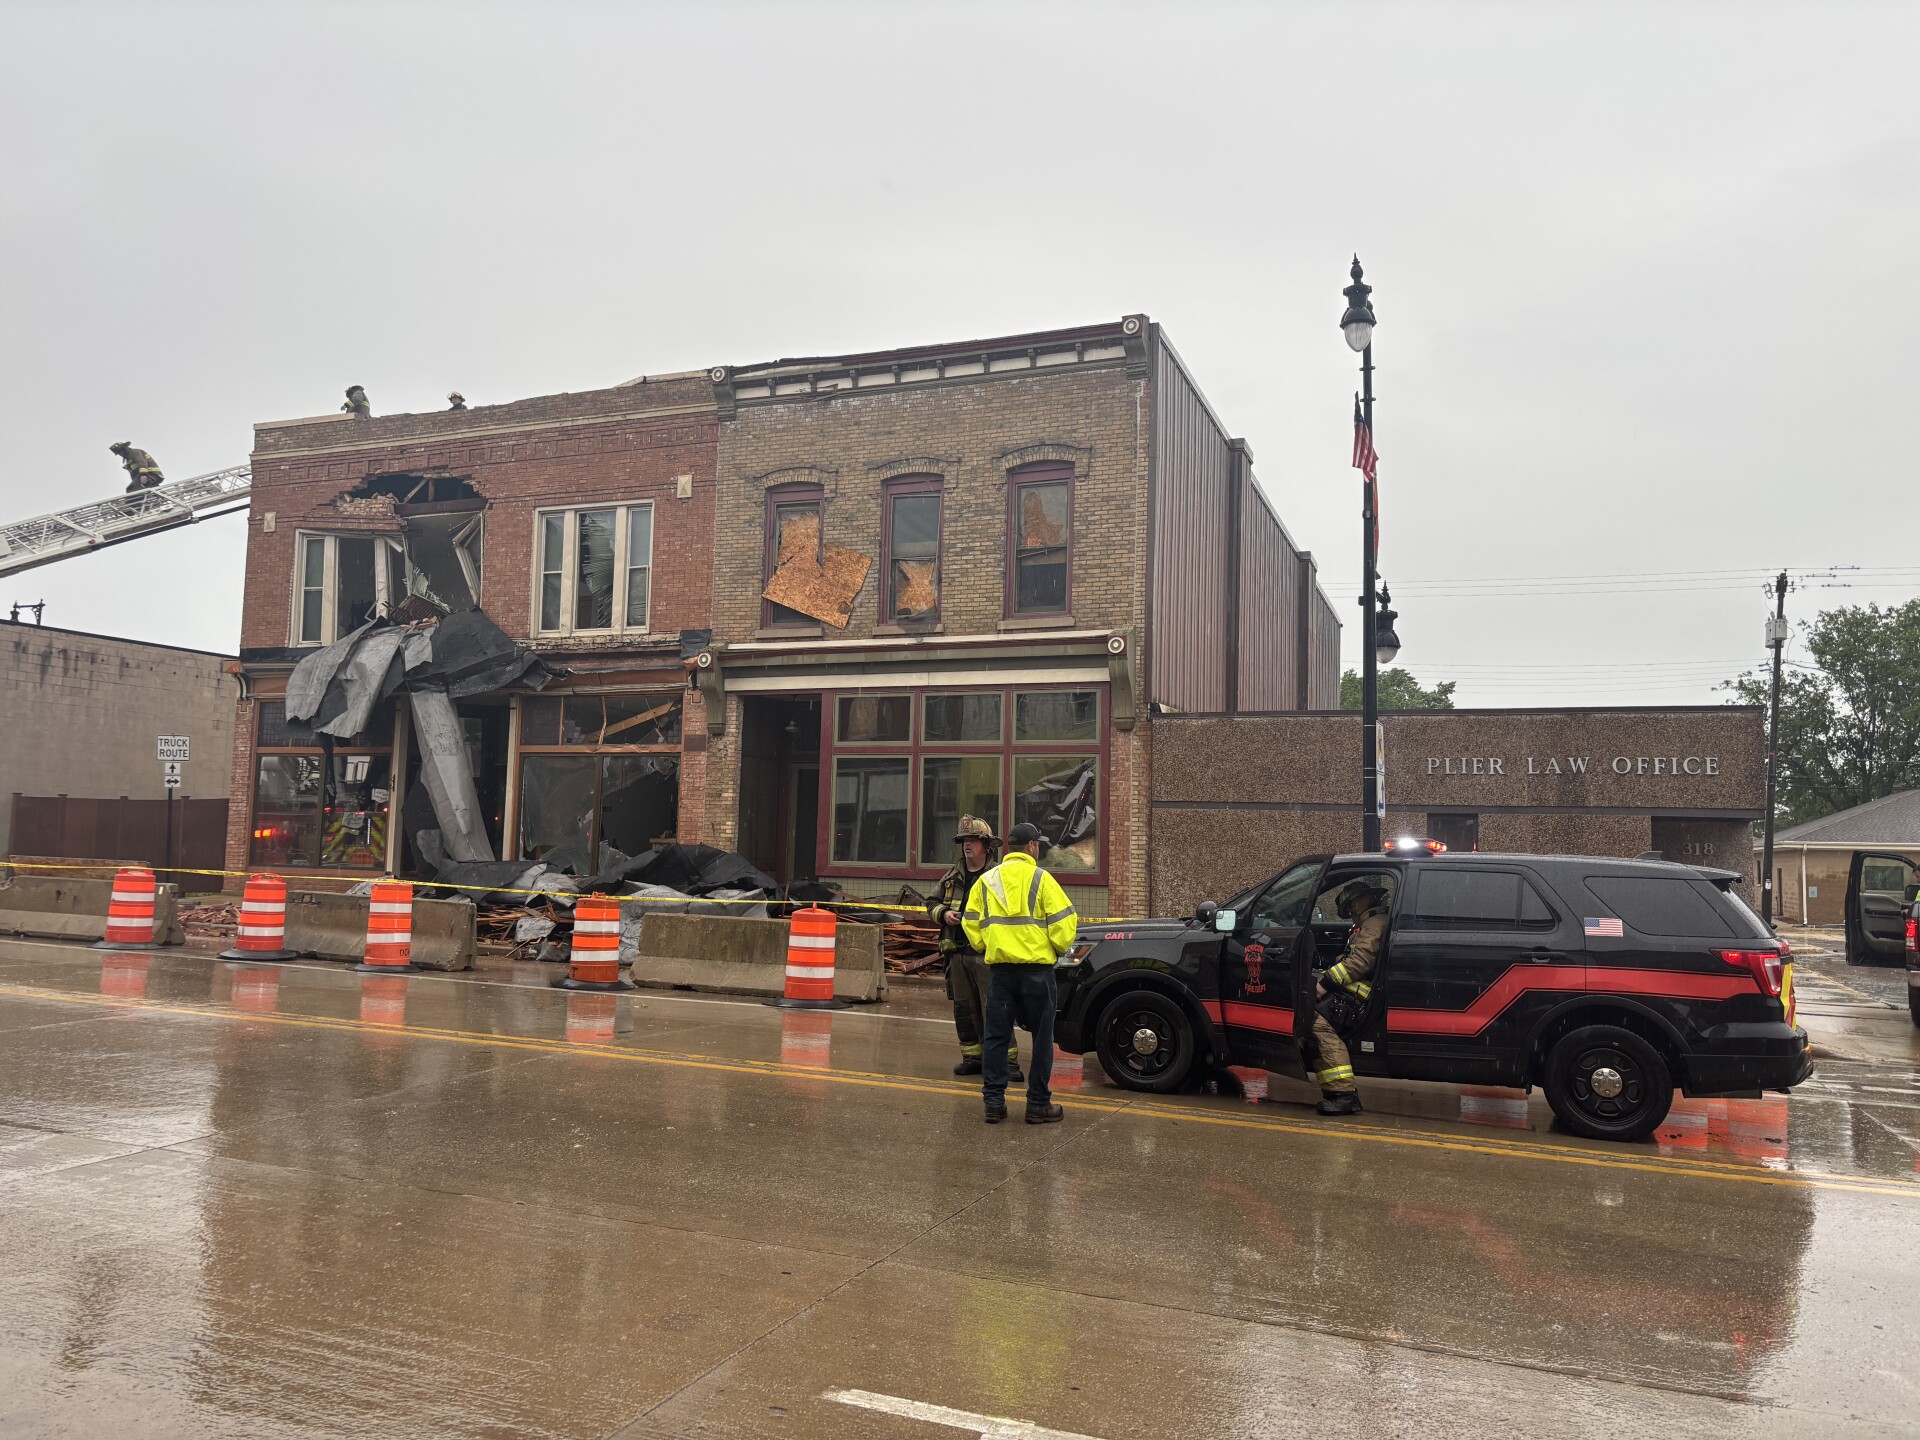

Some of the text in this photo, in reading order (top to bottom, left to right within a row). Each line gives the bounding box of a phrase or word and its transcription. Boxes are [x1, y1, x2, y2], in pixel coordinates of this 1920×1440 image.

[159, 738, 188, 748] TRUCK
[159, 748, 188, 758] ROUTE
[1426, 756, 1720, 775] PLIER LAW OFFICE
[1682, 842, 1714, 856] 318
[1105, 932, 1133, 940] CAR 1
[1245, 983, 1255, 992] FIRE
